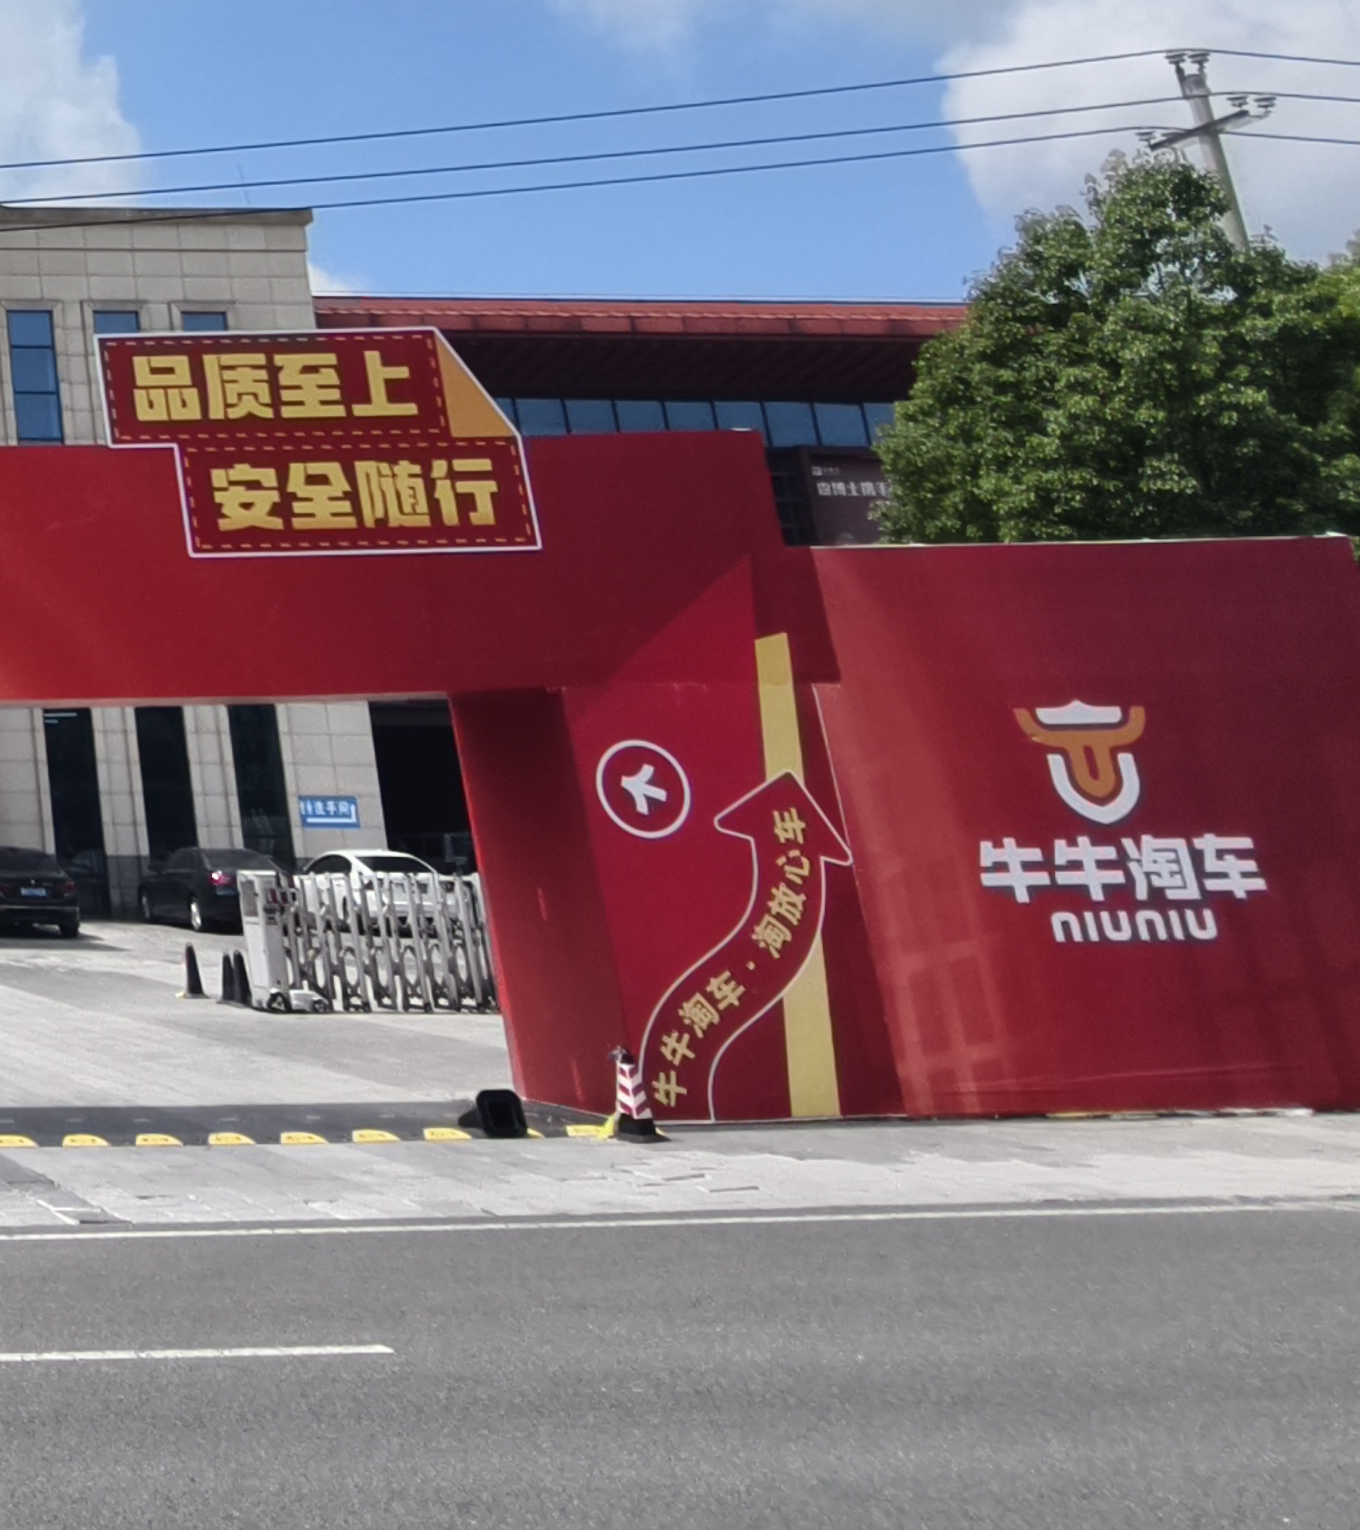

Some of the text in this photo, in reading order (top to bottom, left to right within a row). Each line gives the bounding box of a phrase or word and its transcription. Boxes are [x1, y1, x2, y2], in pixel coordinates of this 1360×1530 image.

[132, 350, 418, 422] 品质至上
[211, 458, 498, 532] 安全随行
[980, 833, 1266, 903] 牛牛淘车
